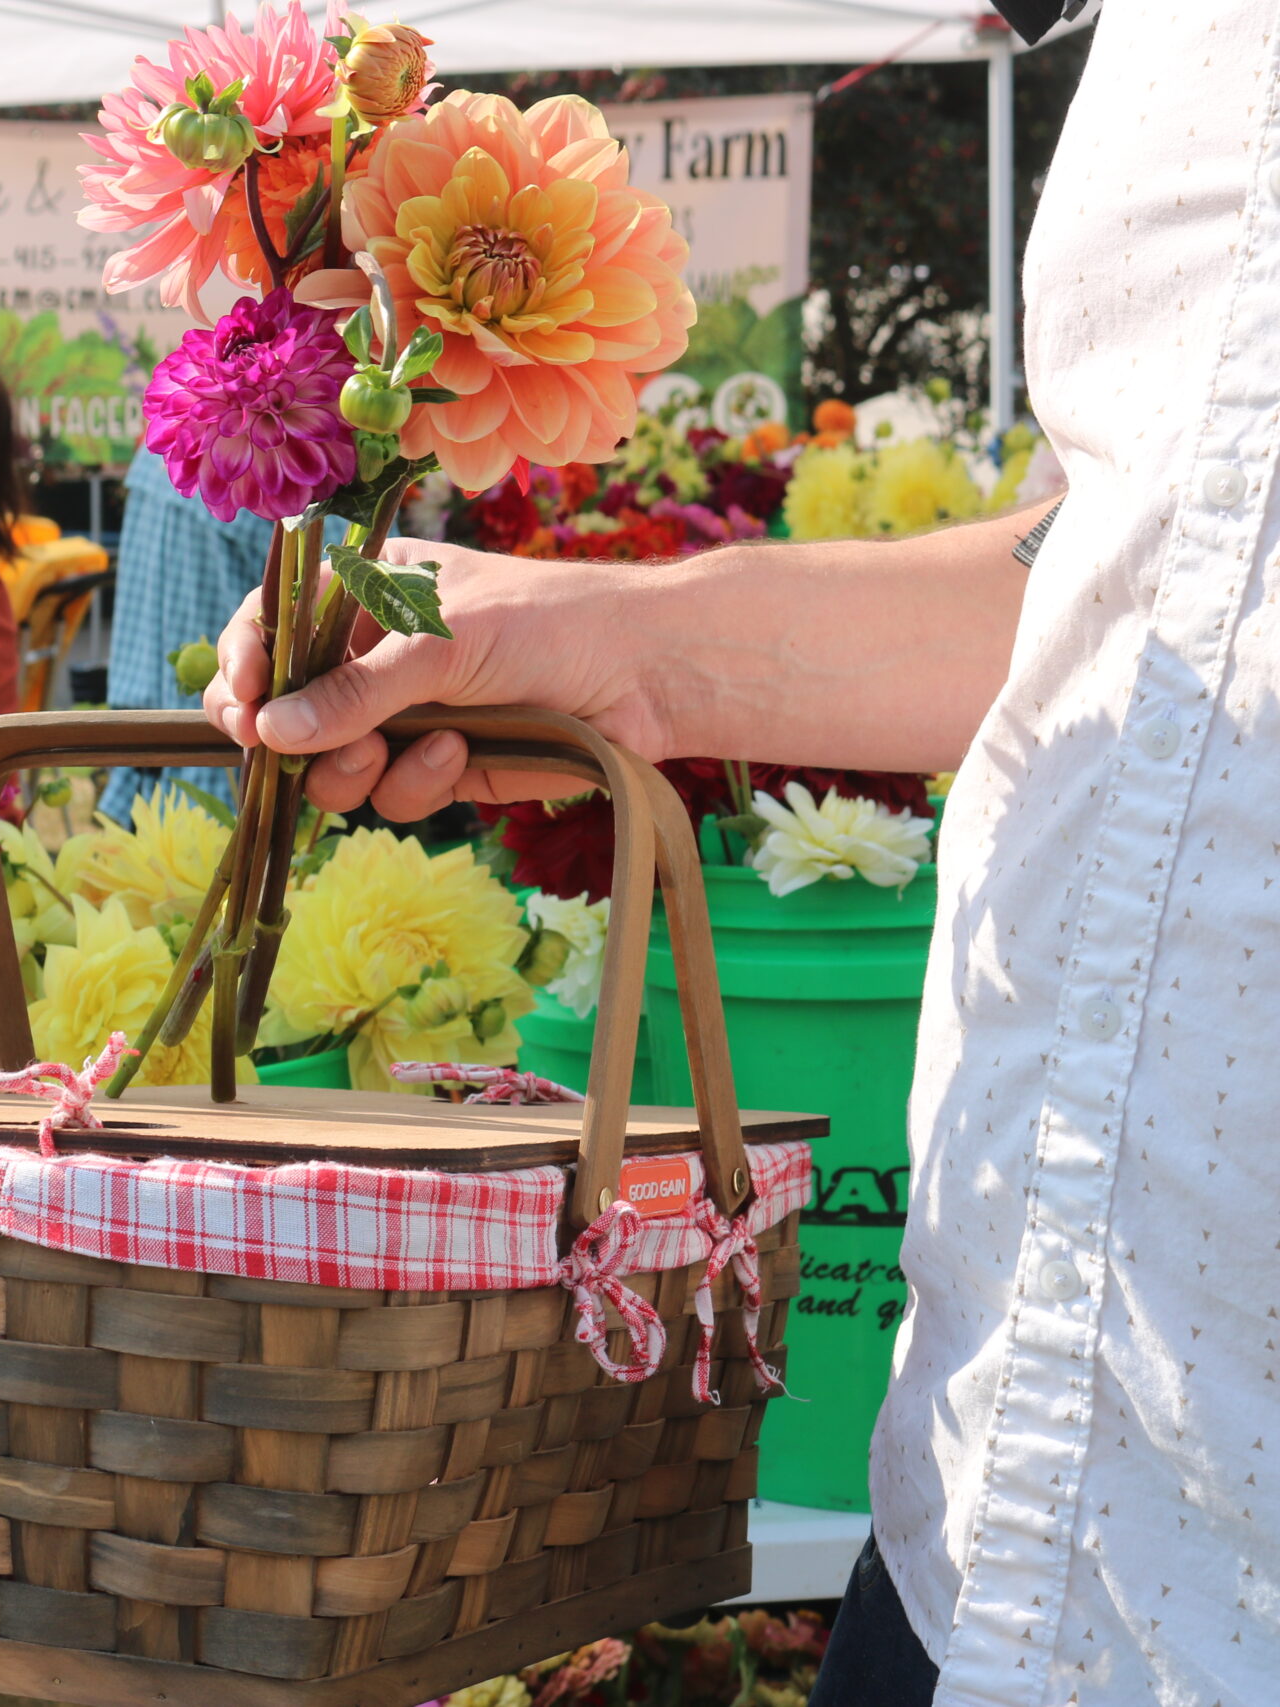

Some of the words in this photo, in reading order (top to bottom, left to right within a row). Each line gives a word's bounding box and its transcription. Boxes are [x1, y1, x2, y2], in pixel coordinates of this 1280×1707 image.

[662, 116, 789, 181] Farm
[50, 395, 144, 439] FACEB
[629, 1181, 659, 1202] GOOD
[660, 1177, 687, 1198] GAIN
[797, 1287, 863, 1317] and
